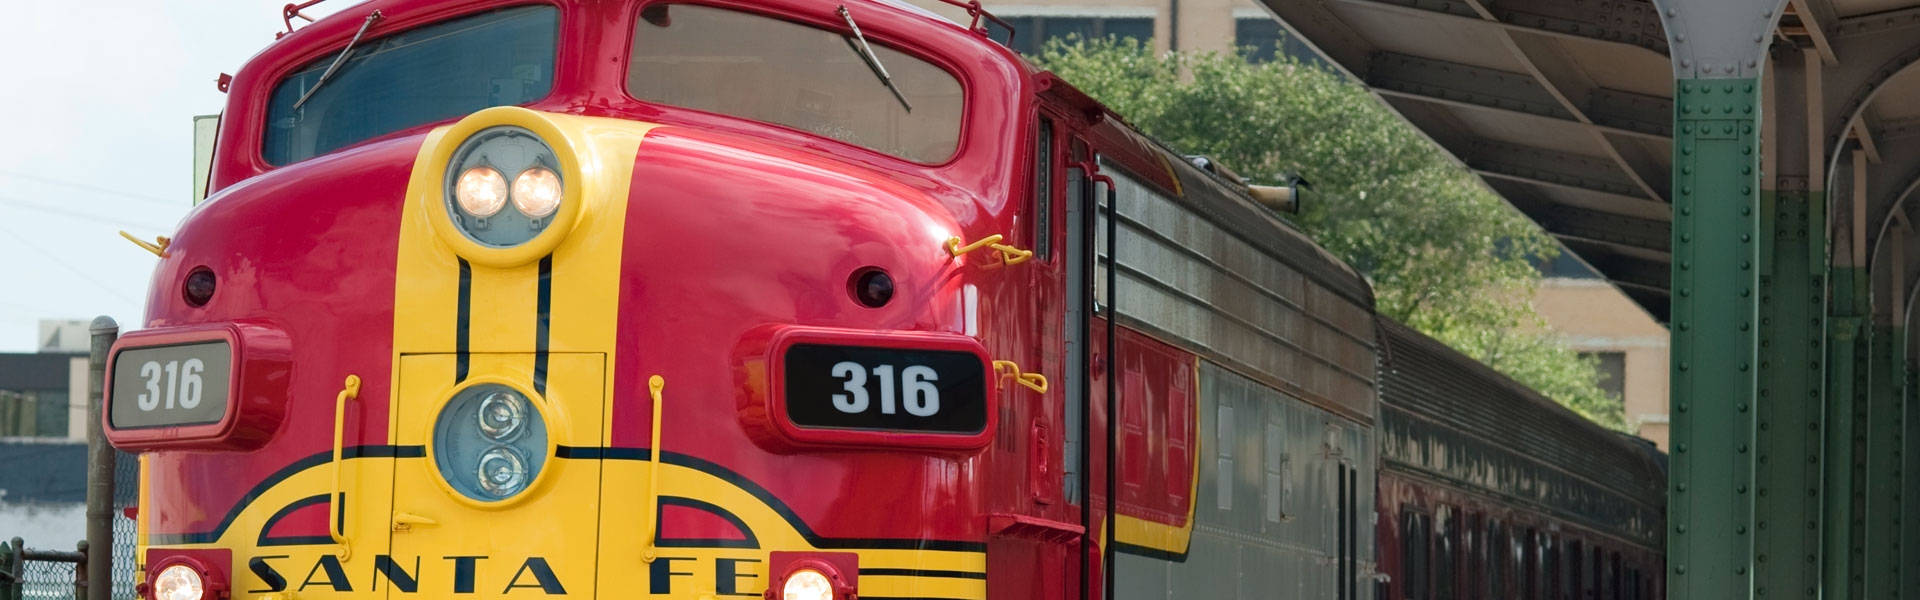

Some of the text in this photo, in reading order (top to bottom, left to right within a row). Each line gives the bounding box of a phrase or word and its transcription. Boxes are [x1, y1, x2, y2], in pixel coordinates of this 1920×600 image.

[138, 358, 204, 411] 316
[831, 361, 940, 417] 316
[247, 554, 762, 597] SANTA FE
